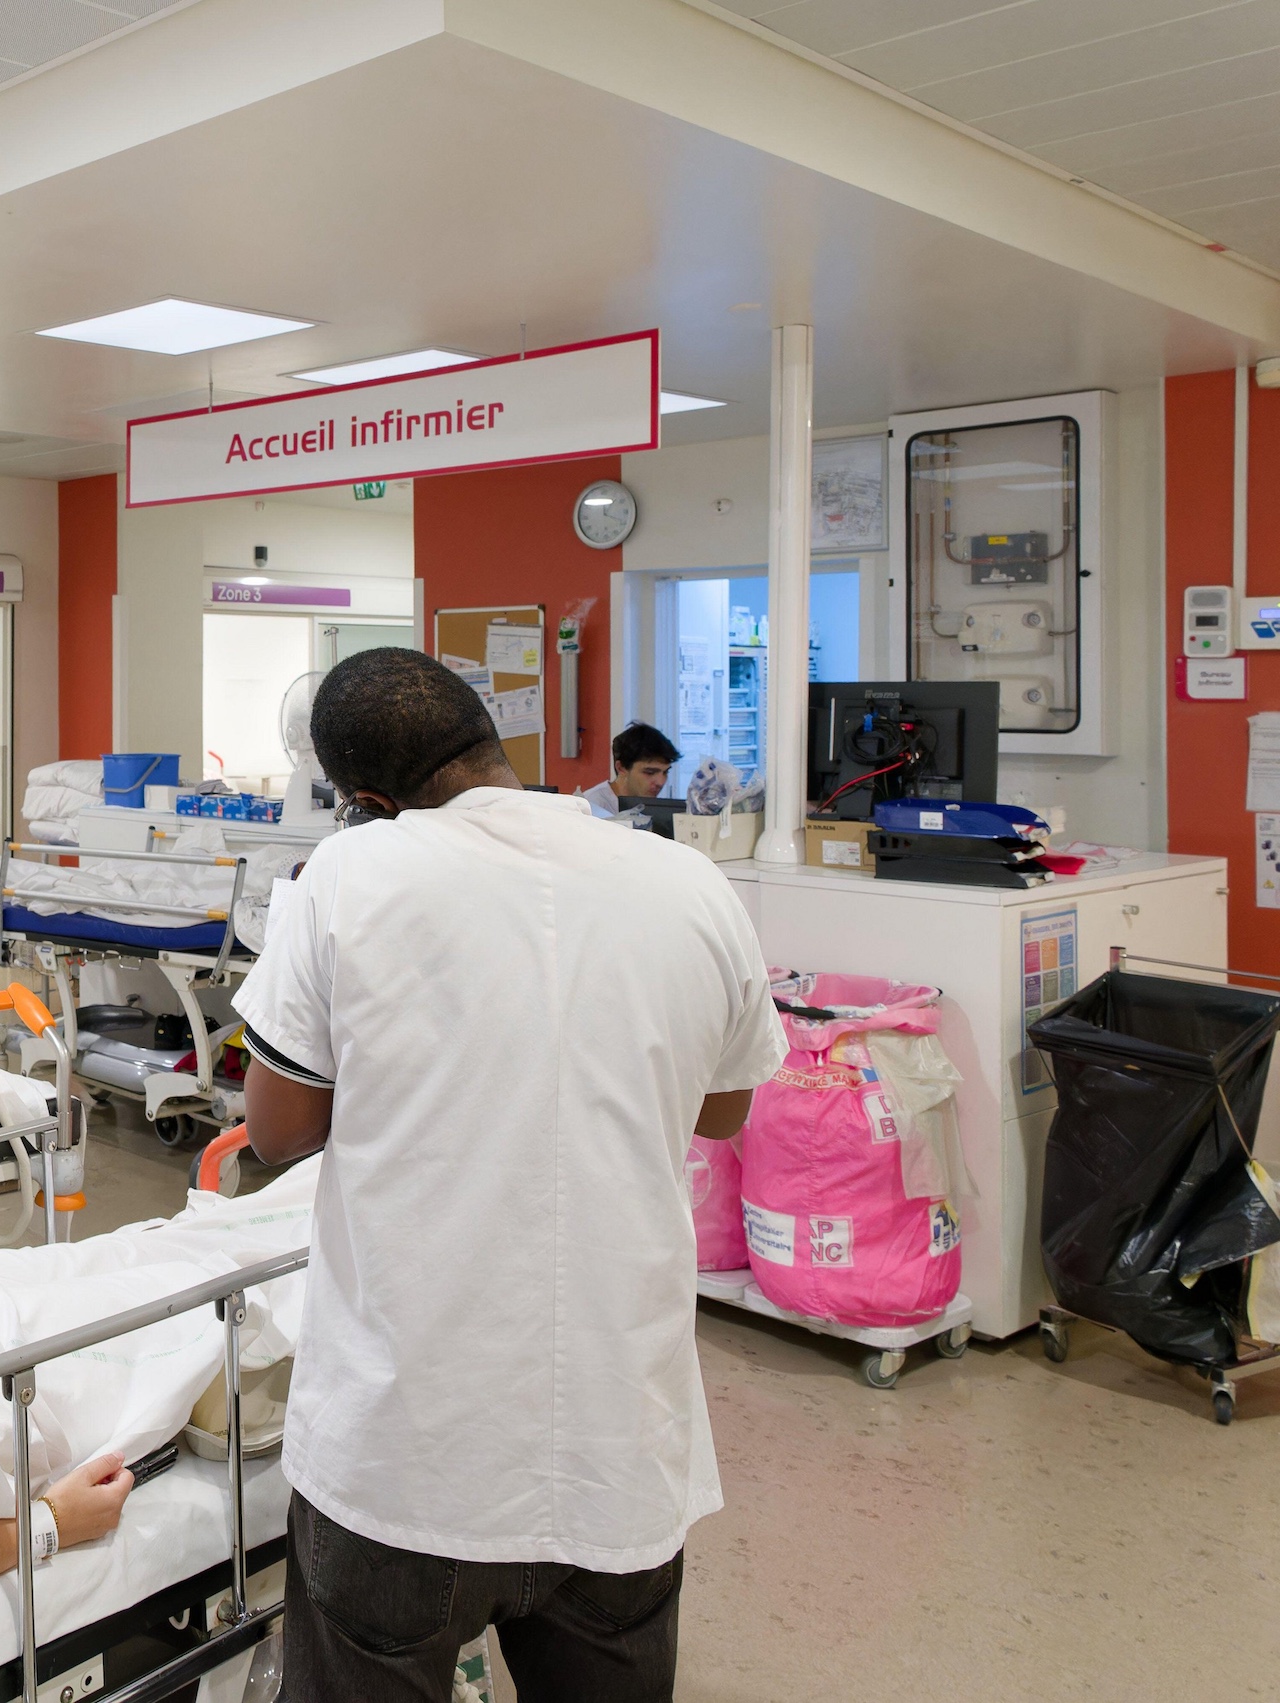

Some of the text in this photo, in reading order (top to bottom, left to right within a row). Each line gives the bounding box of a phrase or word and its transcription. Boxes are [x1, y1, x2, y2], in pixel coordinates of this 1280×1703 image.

[225, 399, 504, 464] Accueil infirmier
[217, 585, 262, 602] Zone 3
